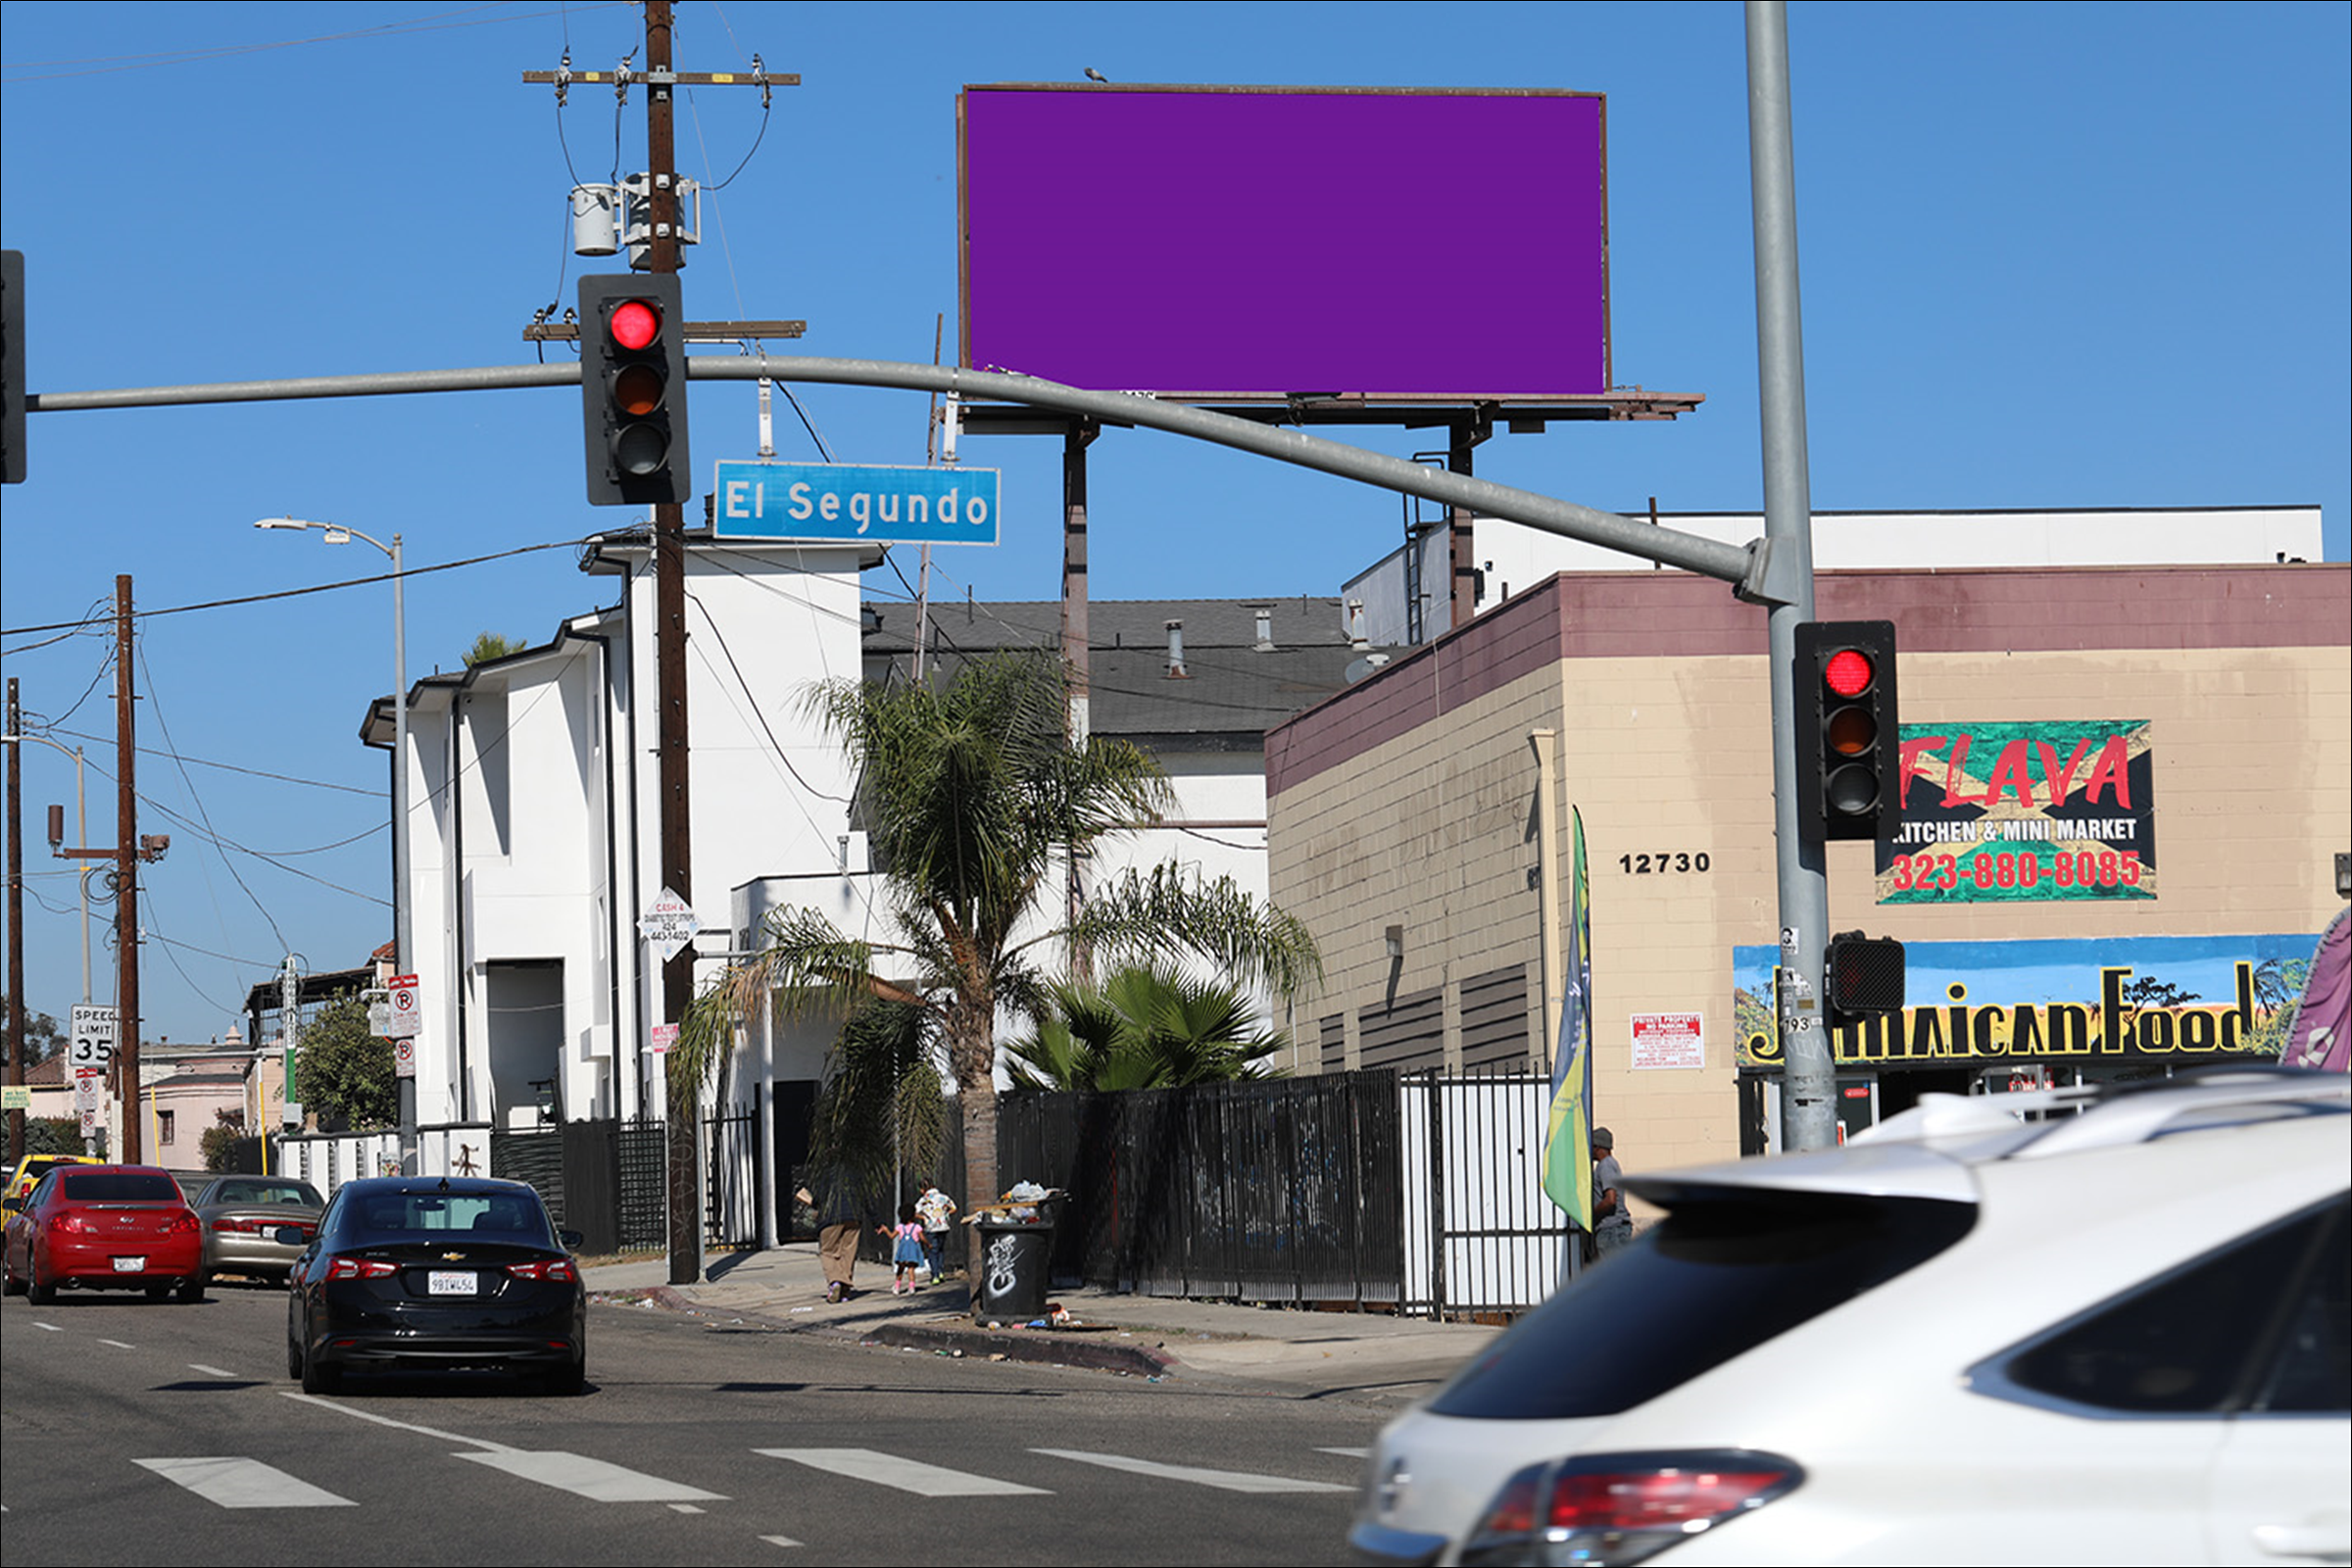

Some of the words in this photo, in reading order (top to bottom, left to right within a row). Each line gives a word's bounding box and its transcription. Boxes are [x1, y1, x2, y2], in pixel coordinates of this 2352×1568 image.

[726, 480, 763, 518] El
[788, 481, 988, 535] Segundo
[1899, 733, 2132, 809] FLAVA
[1983, 820, 1998, 842] &
[2003, 820, 2050, 842] MINI
[2057, 818, 2137, 841] MARKET
[1619, 852, 1710, 874] 12730
[1892, 851, 2140, 890] 323-880-8085
[656, 903, 677, 912] CASH
[662, 922, 677, 931] 424
[1747, 964, 2091, 1063] Jmaican
[2099, 960, 2256, 1054] Food
[78, 1025, 111, 1035] LIMIT
[75, 1039, 113, 1060] 35
